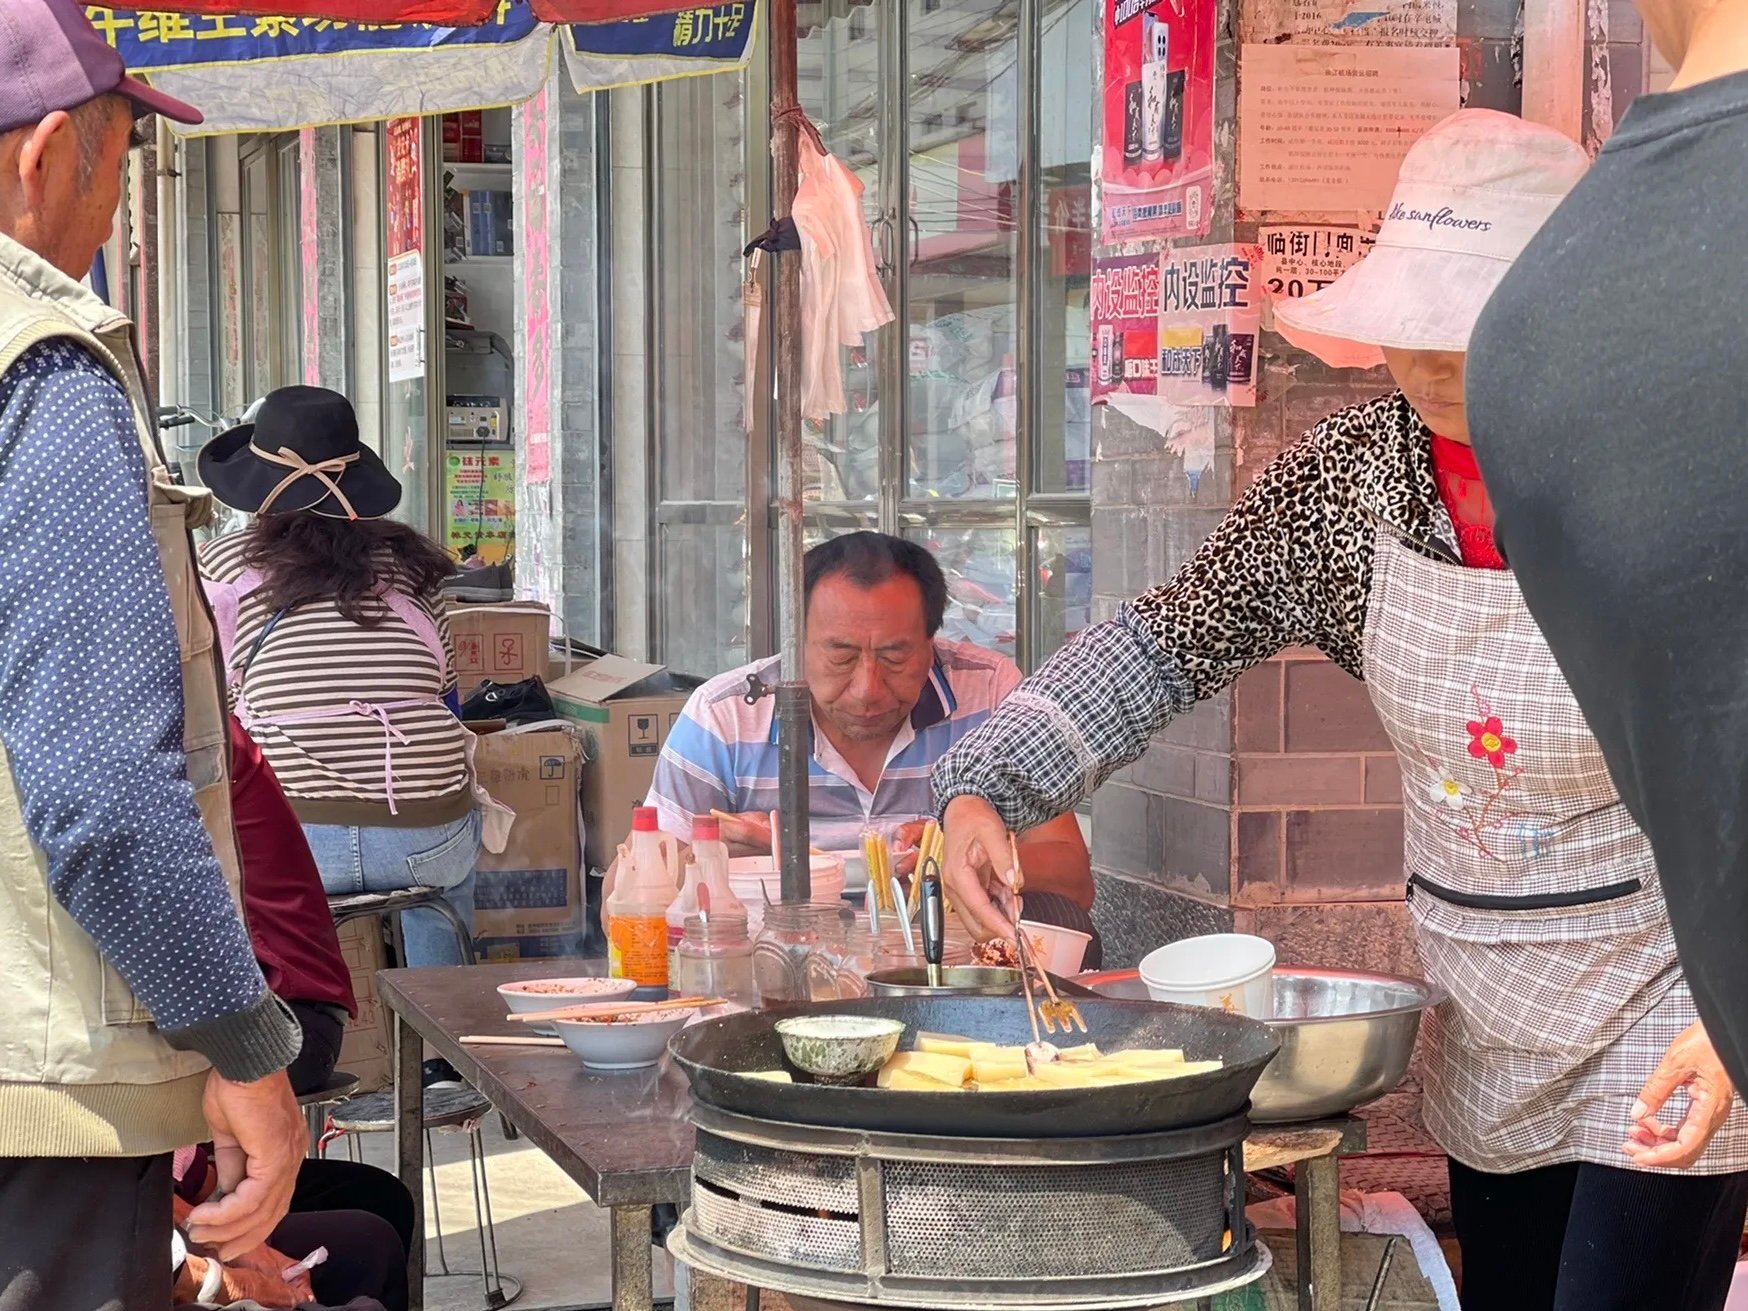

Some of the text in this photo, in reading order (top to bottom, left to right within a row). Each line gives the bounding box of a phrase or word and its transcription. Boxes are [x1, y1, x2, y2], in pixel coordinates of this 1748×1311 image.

[673, 4, 745, 47] 精力十足
[1267, 231, 1376, 258] 临街门面
[1091, 265, 1160, 320] 内设监控
[1164, 257, 1250, 312] 内设监控
